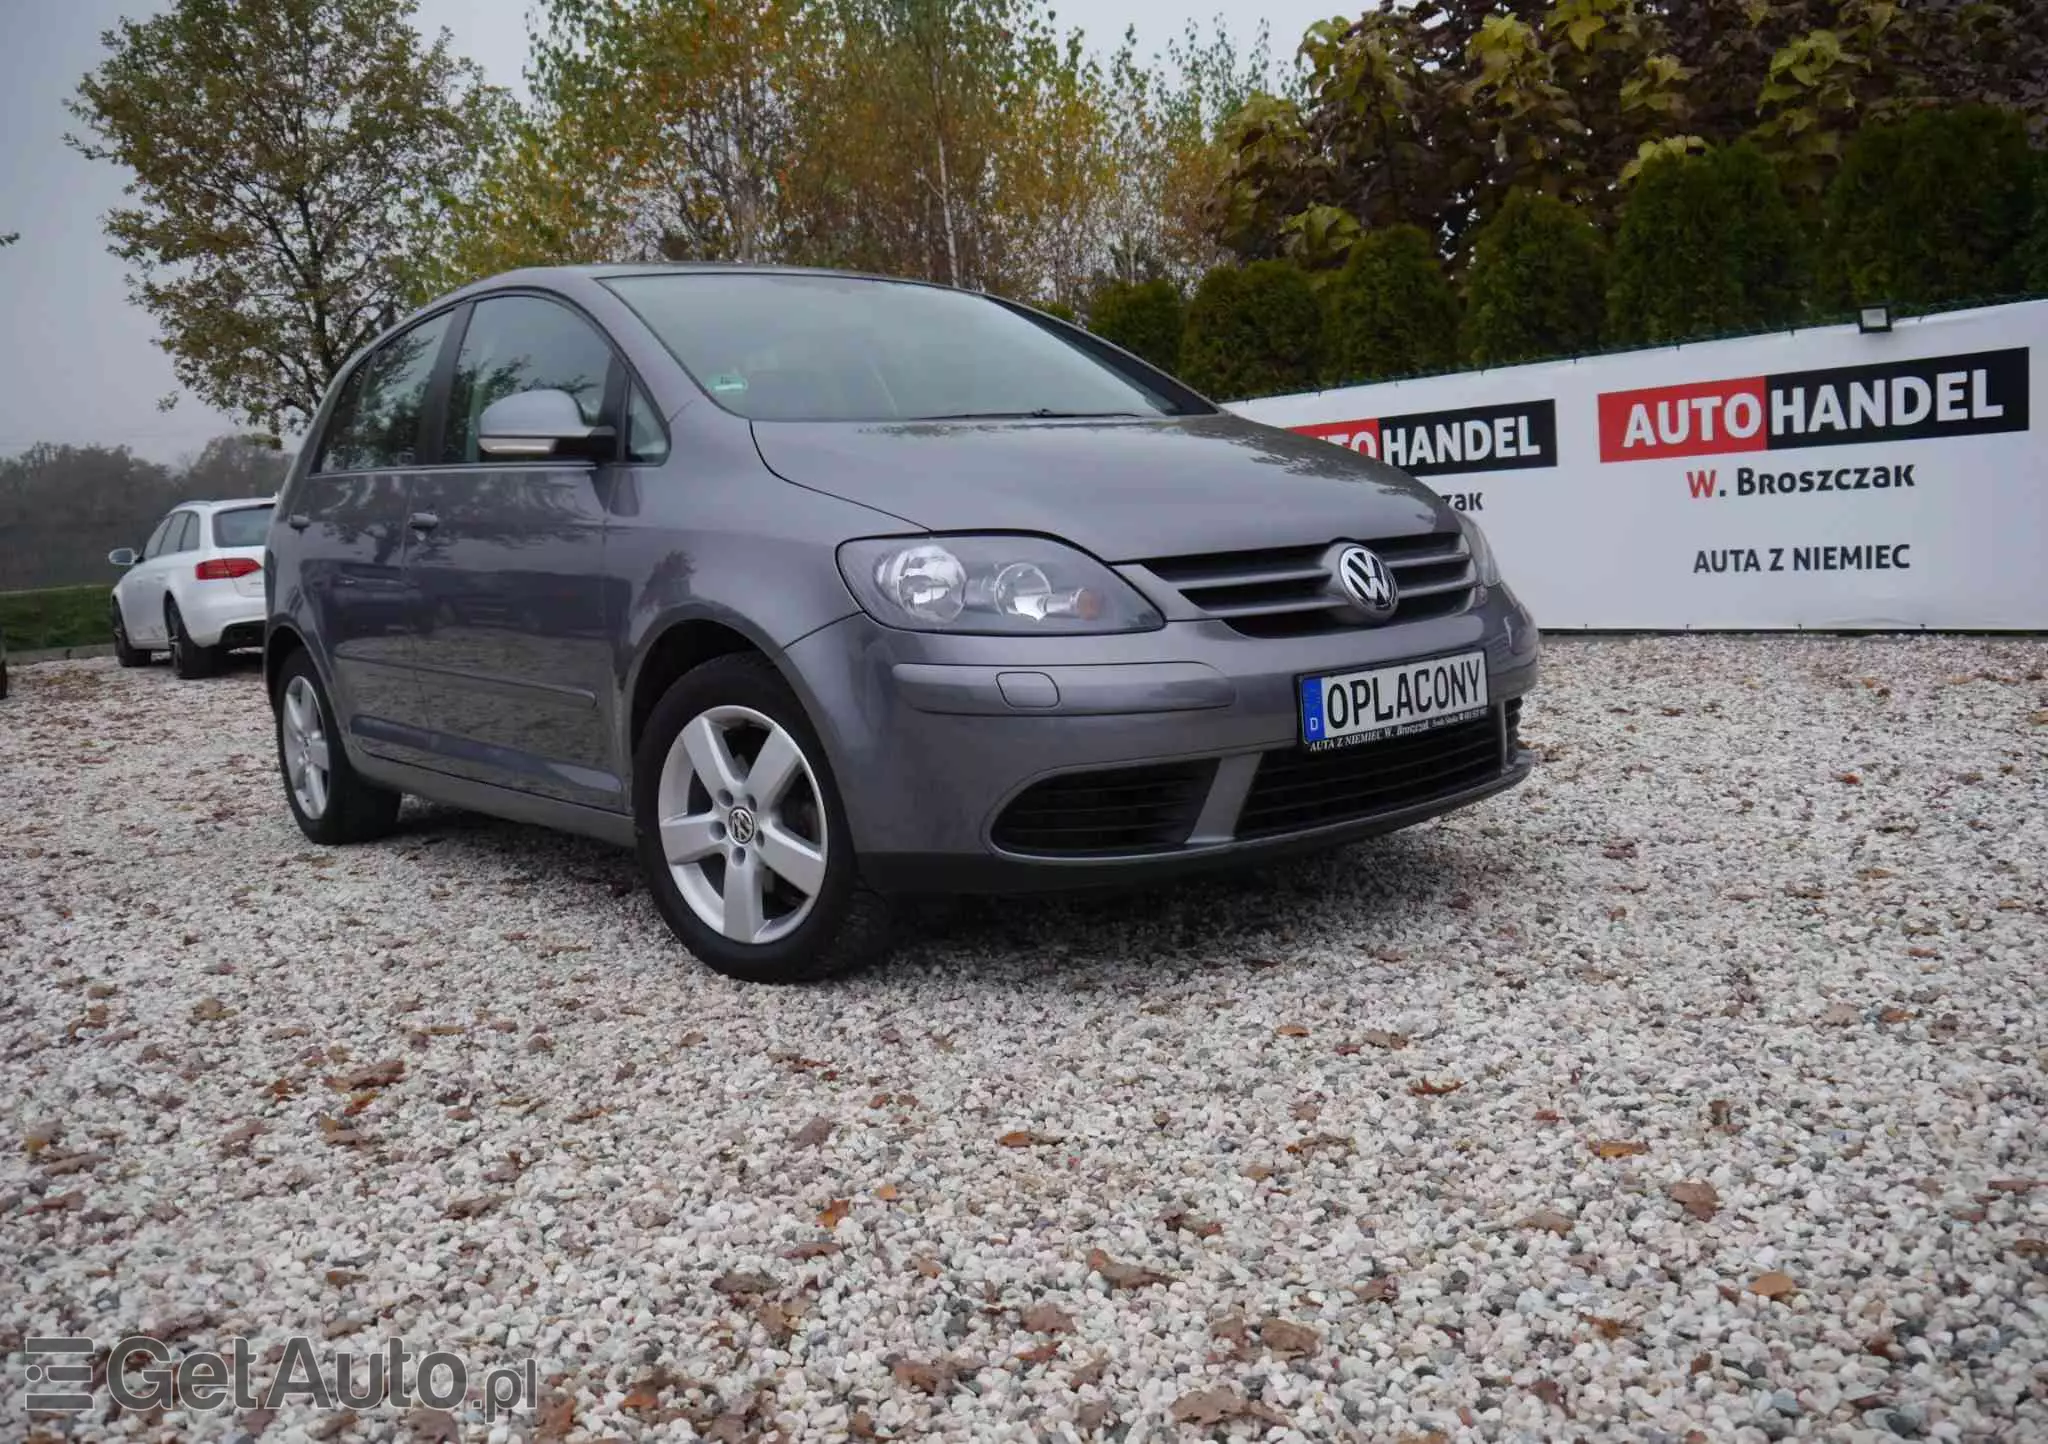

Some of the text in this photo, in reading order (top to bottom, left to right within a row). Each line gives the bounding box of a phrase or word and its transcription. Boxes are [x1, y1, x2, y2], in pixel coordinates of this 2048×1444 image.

[1622, 368, 2004, 449] AUTOHANDEL
[1317, 415, 1541, 466] OHANDEL
[1686, 464, 1916, 498] W. Broszczak
[1694, 544, 1911, 573] AUTA Z NIEMIEC
[1327, 658, 1481, 729] OPLACONY
[1309, 717, 1319, 731] D
